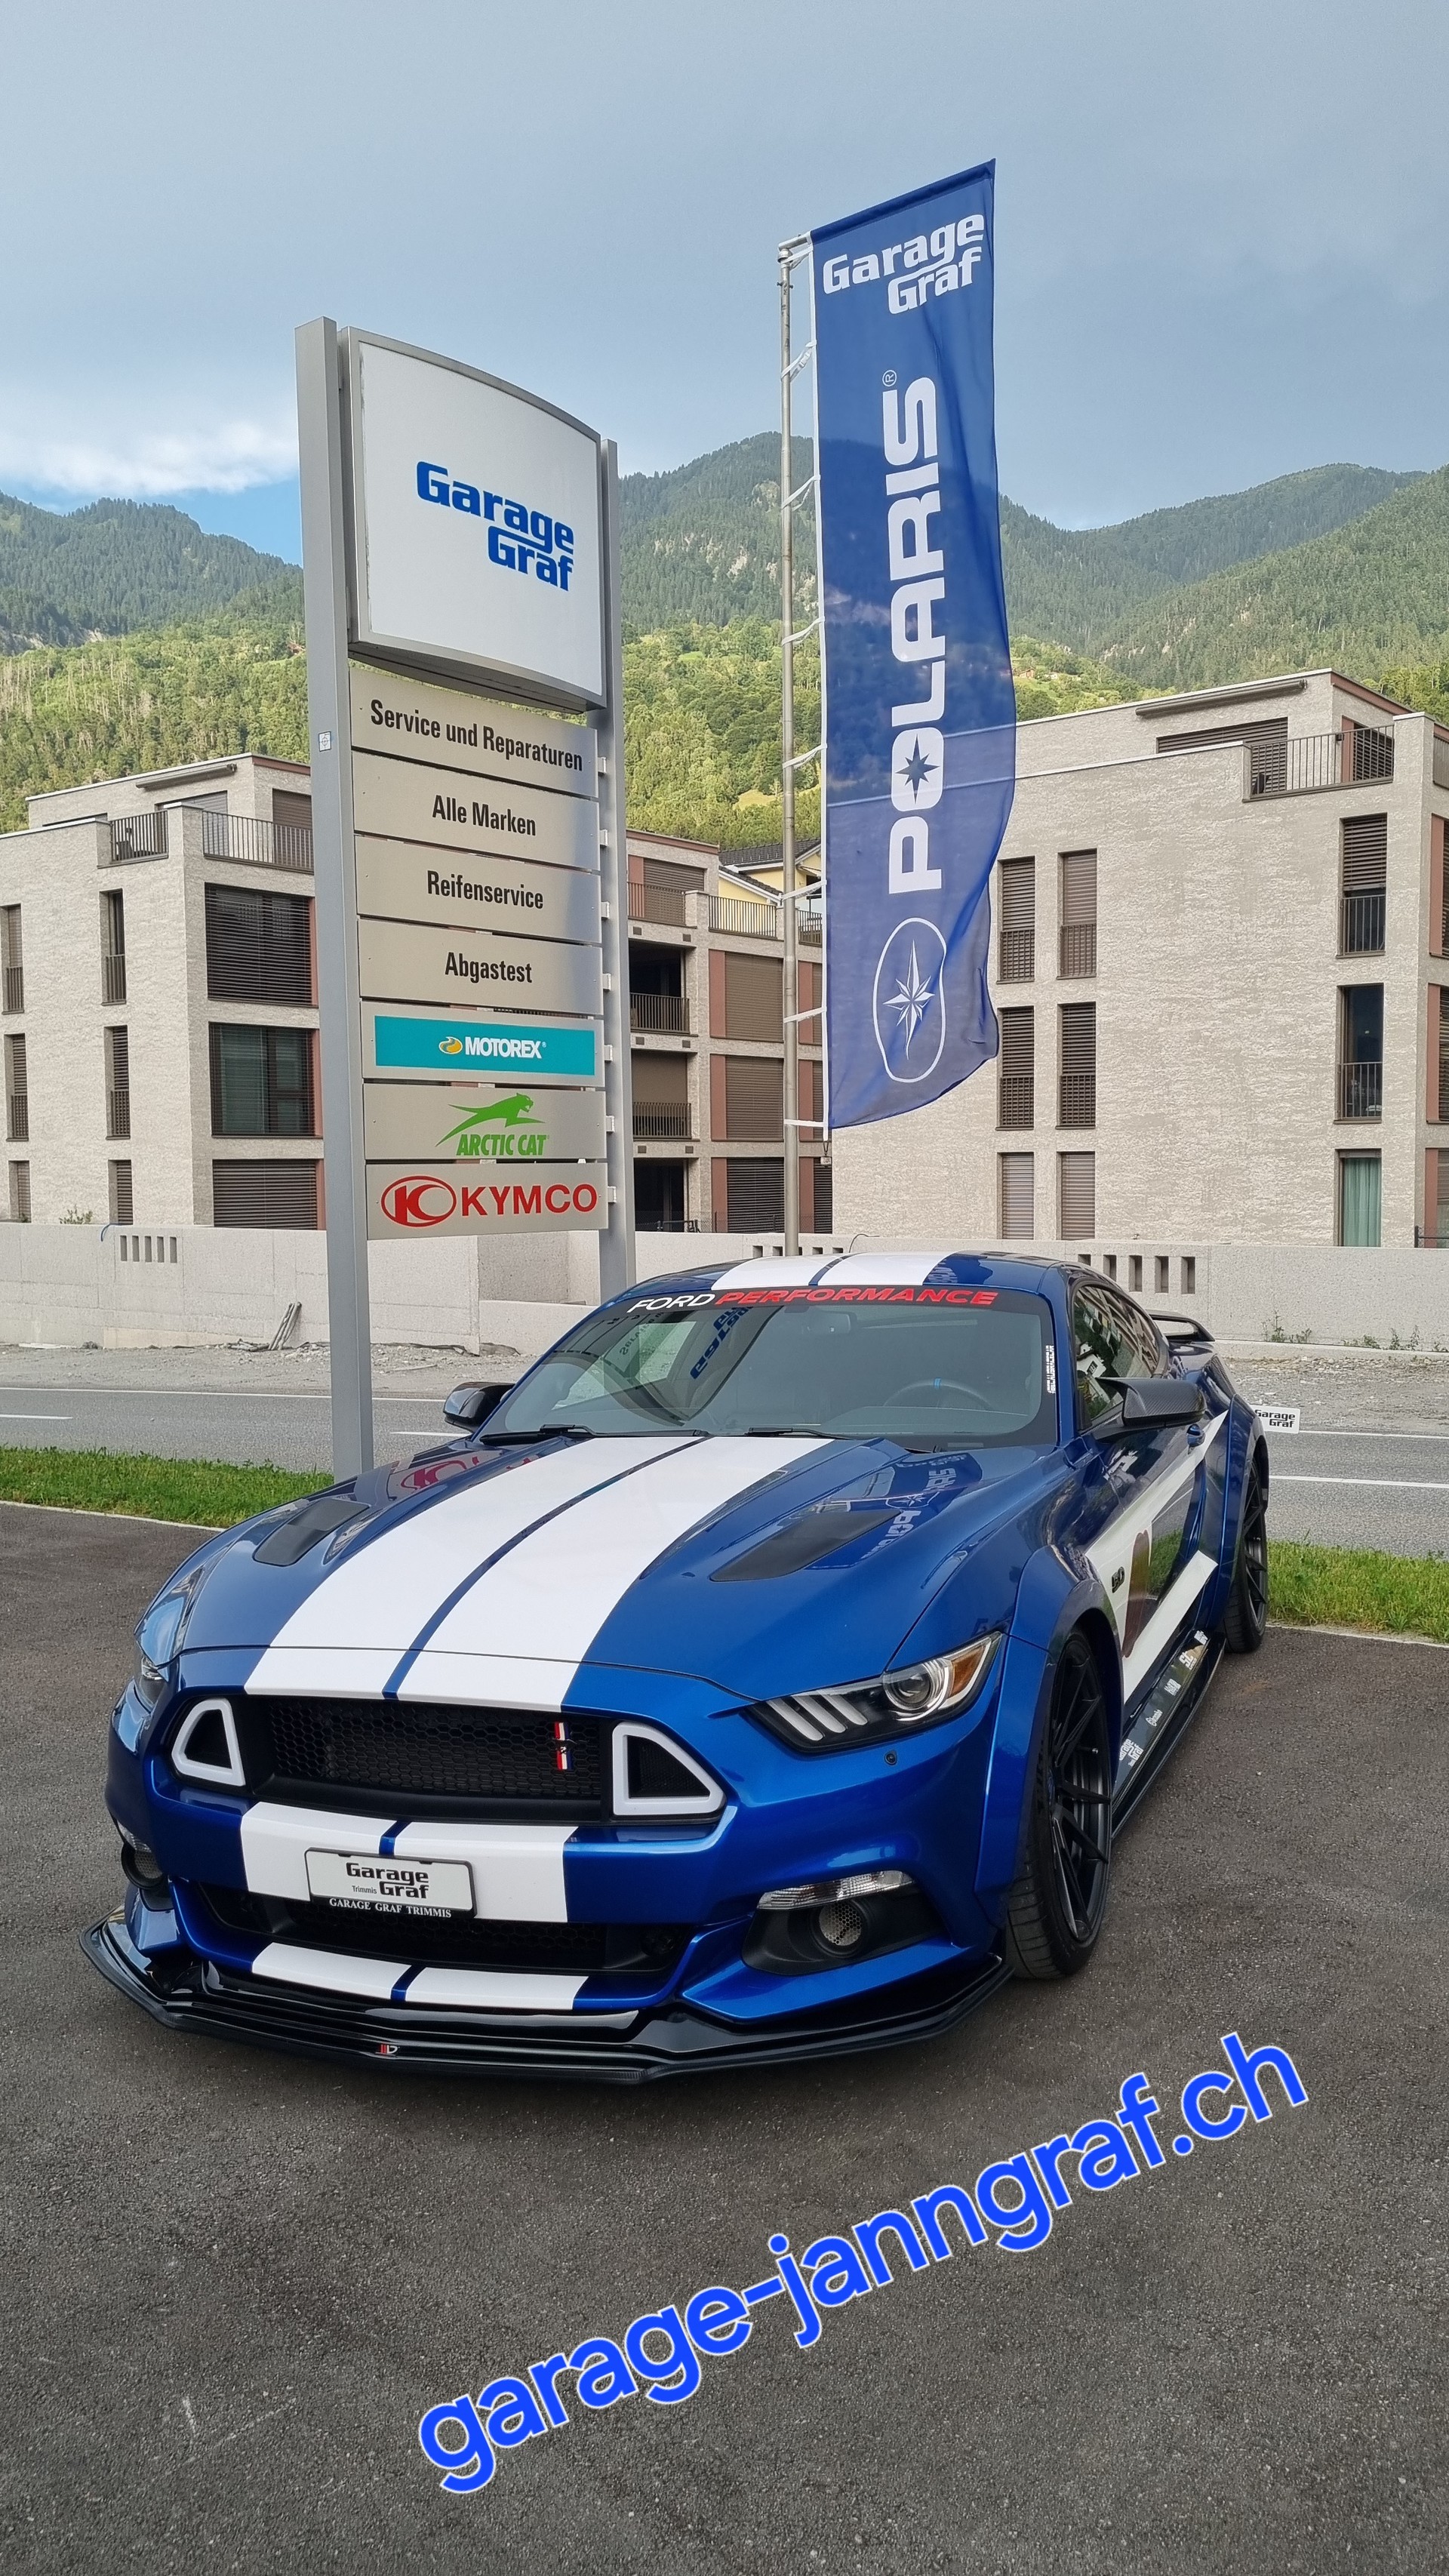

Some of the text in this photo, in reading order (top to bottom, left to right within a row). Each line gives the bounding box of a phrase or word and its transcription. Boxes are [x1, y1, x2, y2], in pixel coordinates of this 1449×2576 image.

[823, 214, 985, 294] Garage
[888, 246, 982, 314] Graf
[416, 461, 574, 555] Garage
[487, 525, 574, 592] Graf
[371, 700, 583, 771] Service und Reparaturen
[432, 795, 537, 836] Alle Marken
[427, 870, 543, 909] Reifenservice
[445, 952, 532, 983] Abgastest
[456, 1134, 547, 1156] ARCTIC CAT
[461, 1183, 598, 1217] KYMCO
[626, 1288, 999, 1313] FORD PERFORMANCE
[1254, 1409, 1296, 1421] Garage
[1269, 1418, 1295, 1427] Graf
[346, 1862, 429, 1885] Garage
[352, 1881, 429, 1899] Trimmis Graf
[329, 1897, 451, 1918] GARAGE GRAF TRIMMIS
